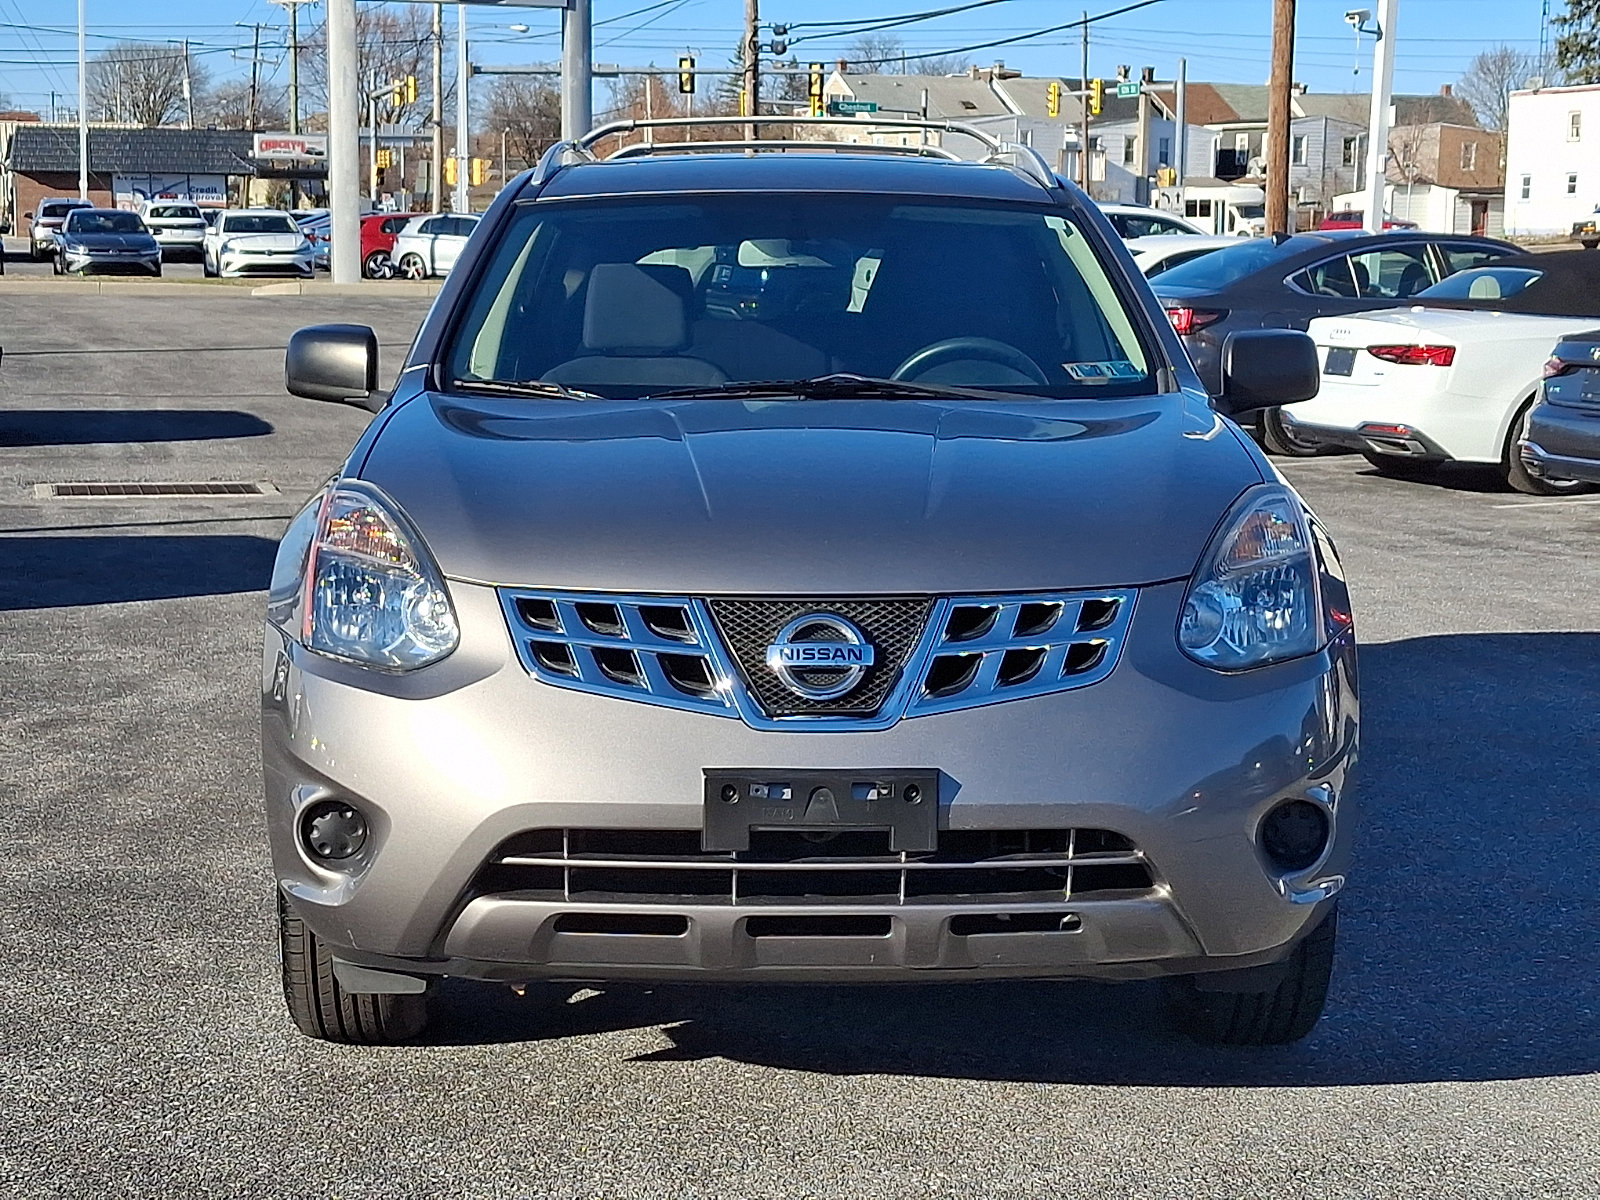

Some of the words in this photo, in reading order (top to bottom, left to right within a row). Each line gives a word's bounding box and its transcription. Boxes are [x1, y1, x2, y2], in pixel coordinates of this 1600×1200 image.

[838, 103, 871, 111] Chestnut
[260, 140, 306, 153] CHUCKY'S
[189, 186, 219, 194] Credit
[779, 647, 863, 661] NISSAN
